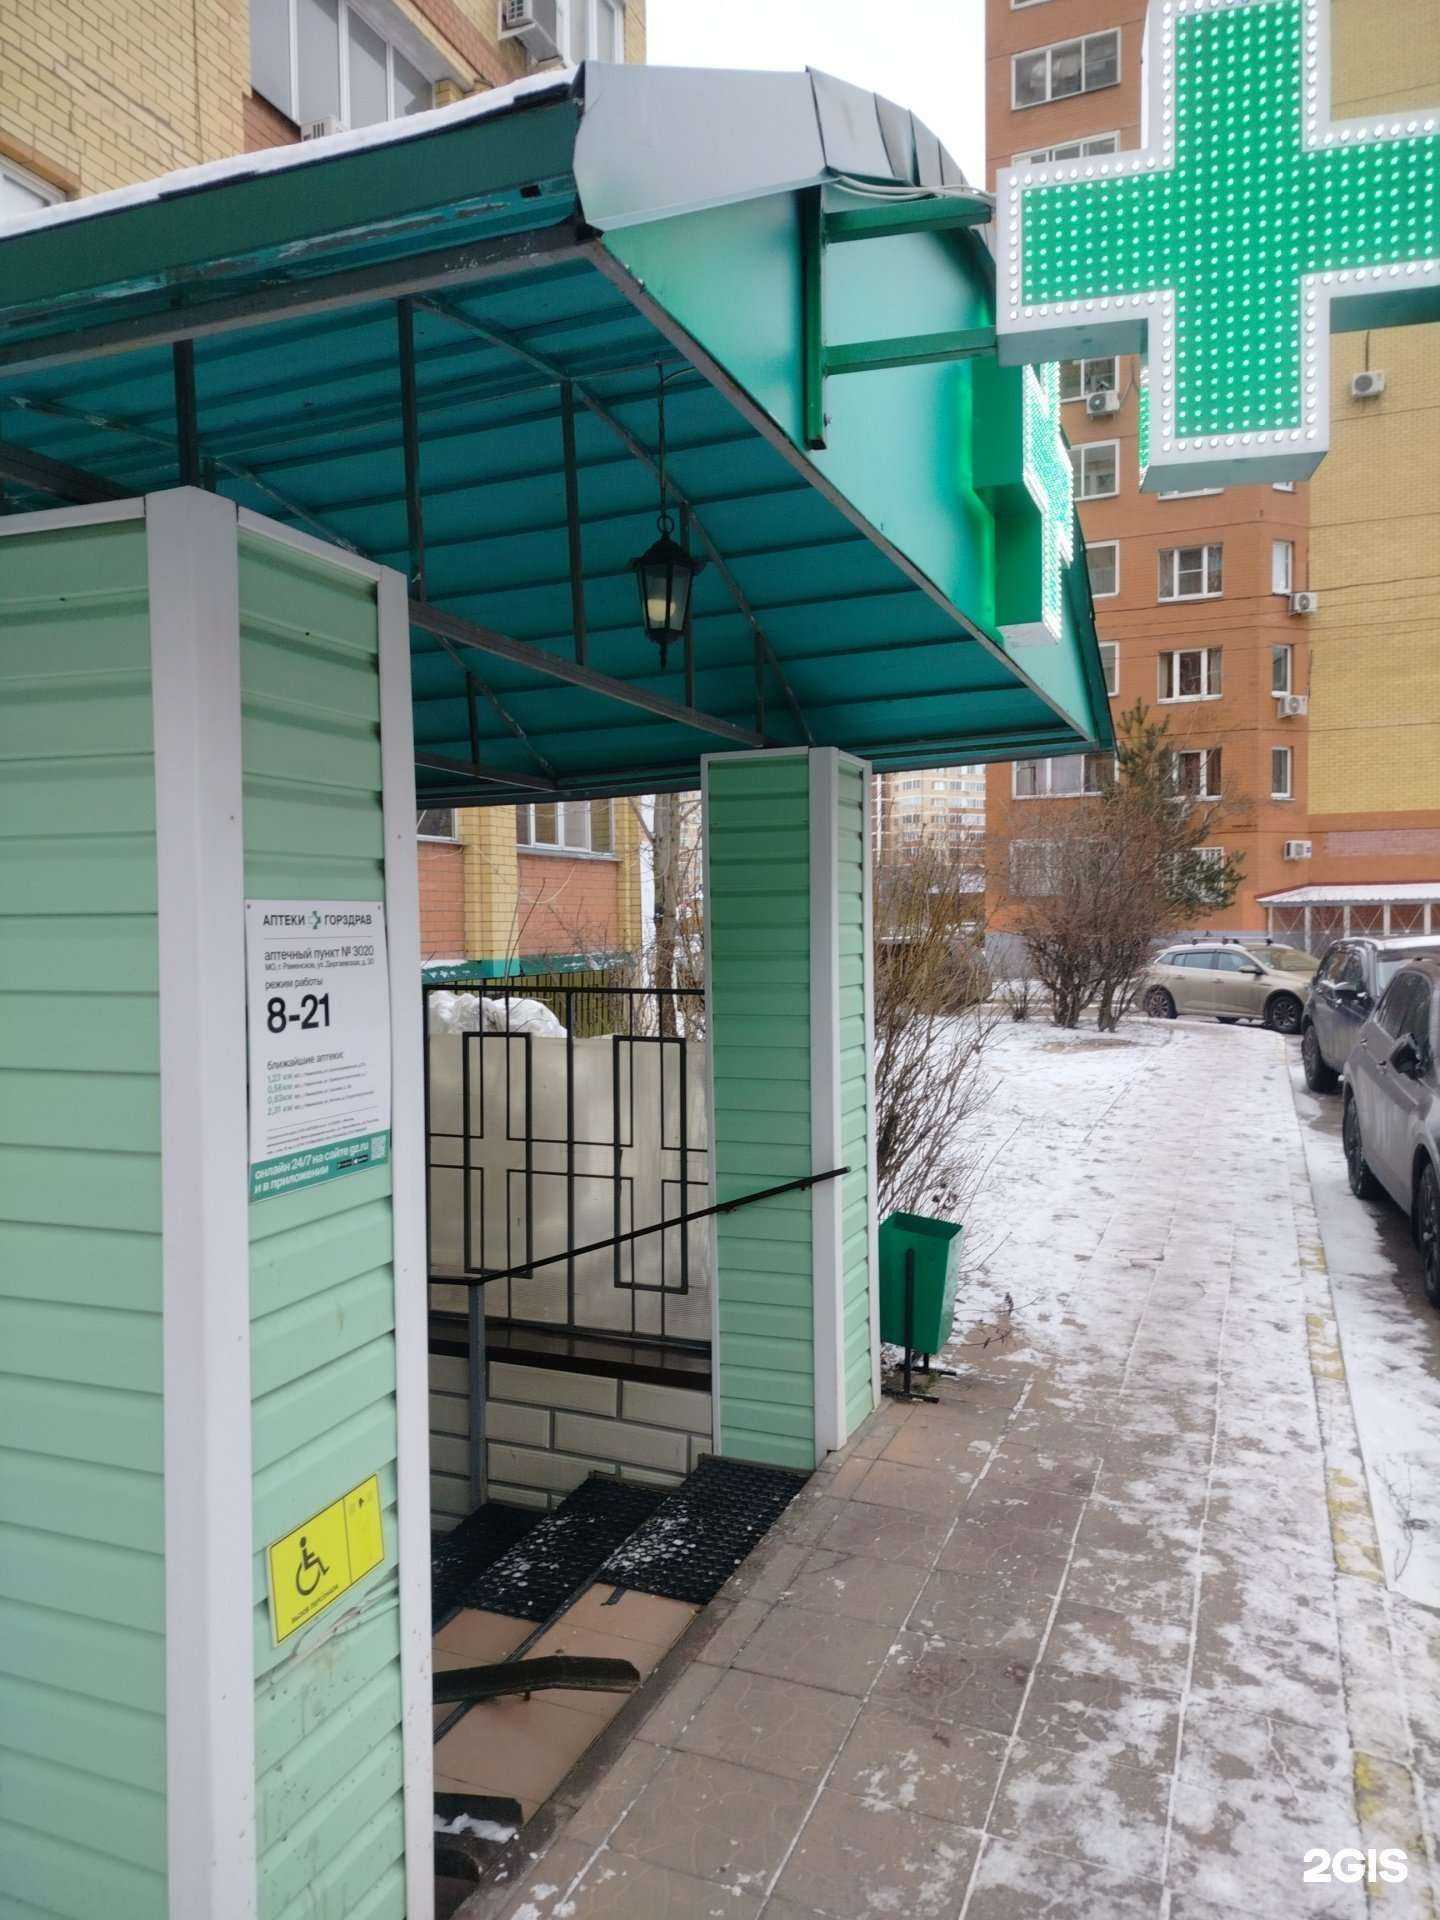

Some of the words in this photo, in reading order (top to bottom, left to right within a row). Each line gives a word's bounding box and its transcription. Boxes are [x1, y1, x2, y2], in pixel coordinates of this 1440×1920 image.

[263, 914, 305, 926] АПТЕКИ
[324, 914, 372, 927] ГОРЗДРАВ
[264, 948, 312, 961] аптечный
[314, 949, 340, 960] пункт
[341, 946, 352, 957] №
[353, 944, 374, 957] 3020
[264, 980, 293, 991] режим
[294, 976, 323, 988] работы
[267, 992, 330, 1034] 8-21
[254, 1161, 291, 1179] онлайн
[291, 1154, 311, 1170] 24/7
[312, 1154, 324, 1164] на
[324, 1146, 349, 1161] сайте
[254, 1185, 262, 1194] и
[262, 1182, 270, 1192] в
